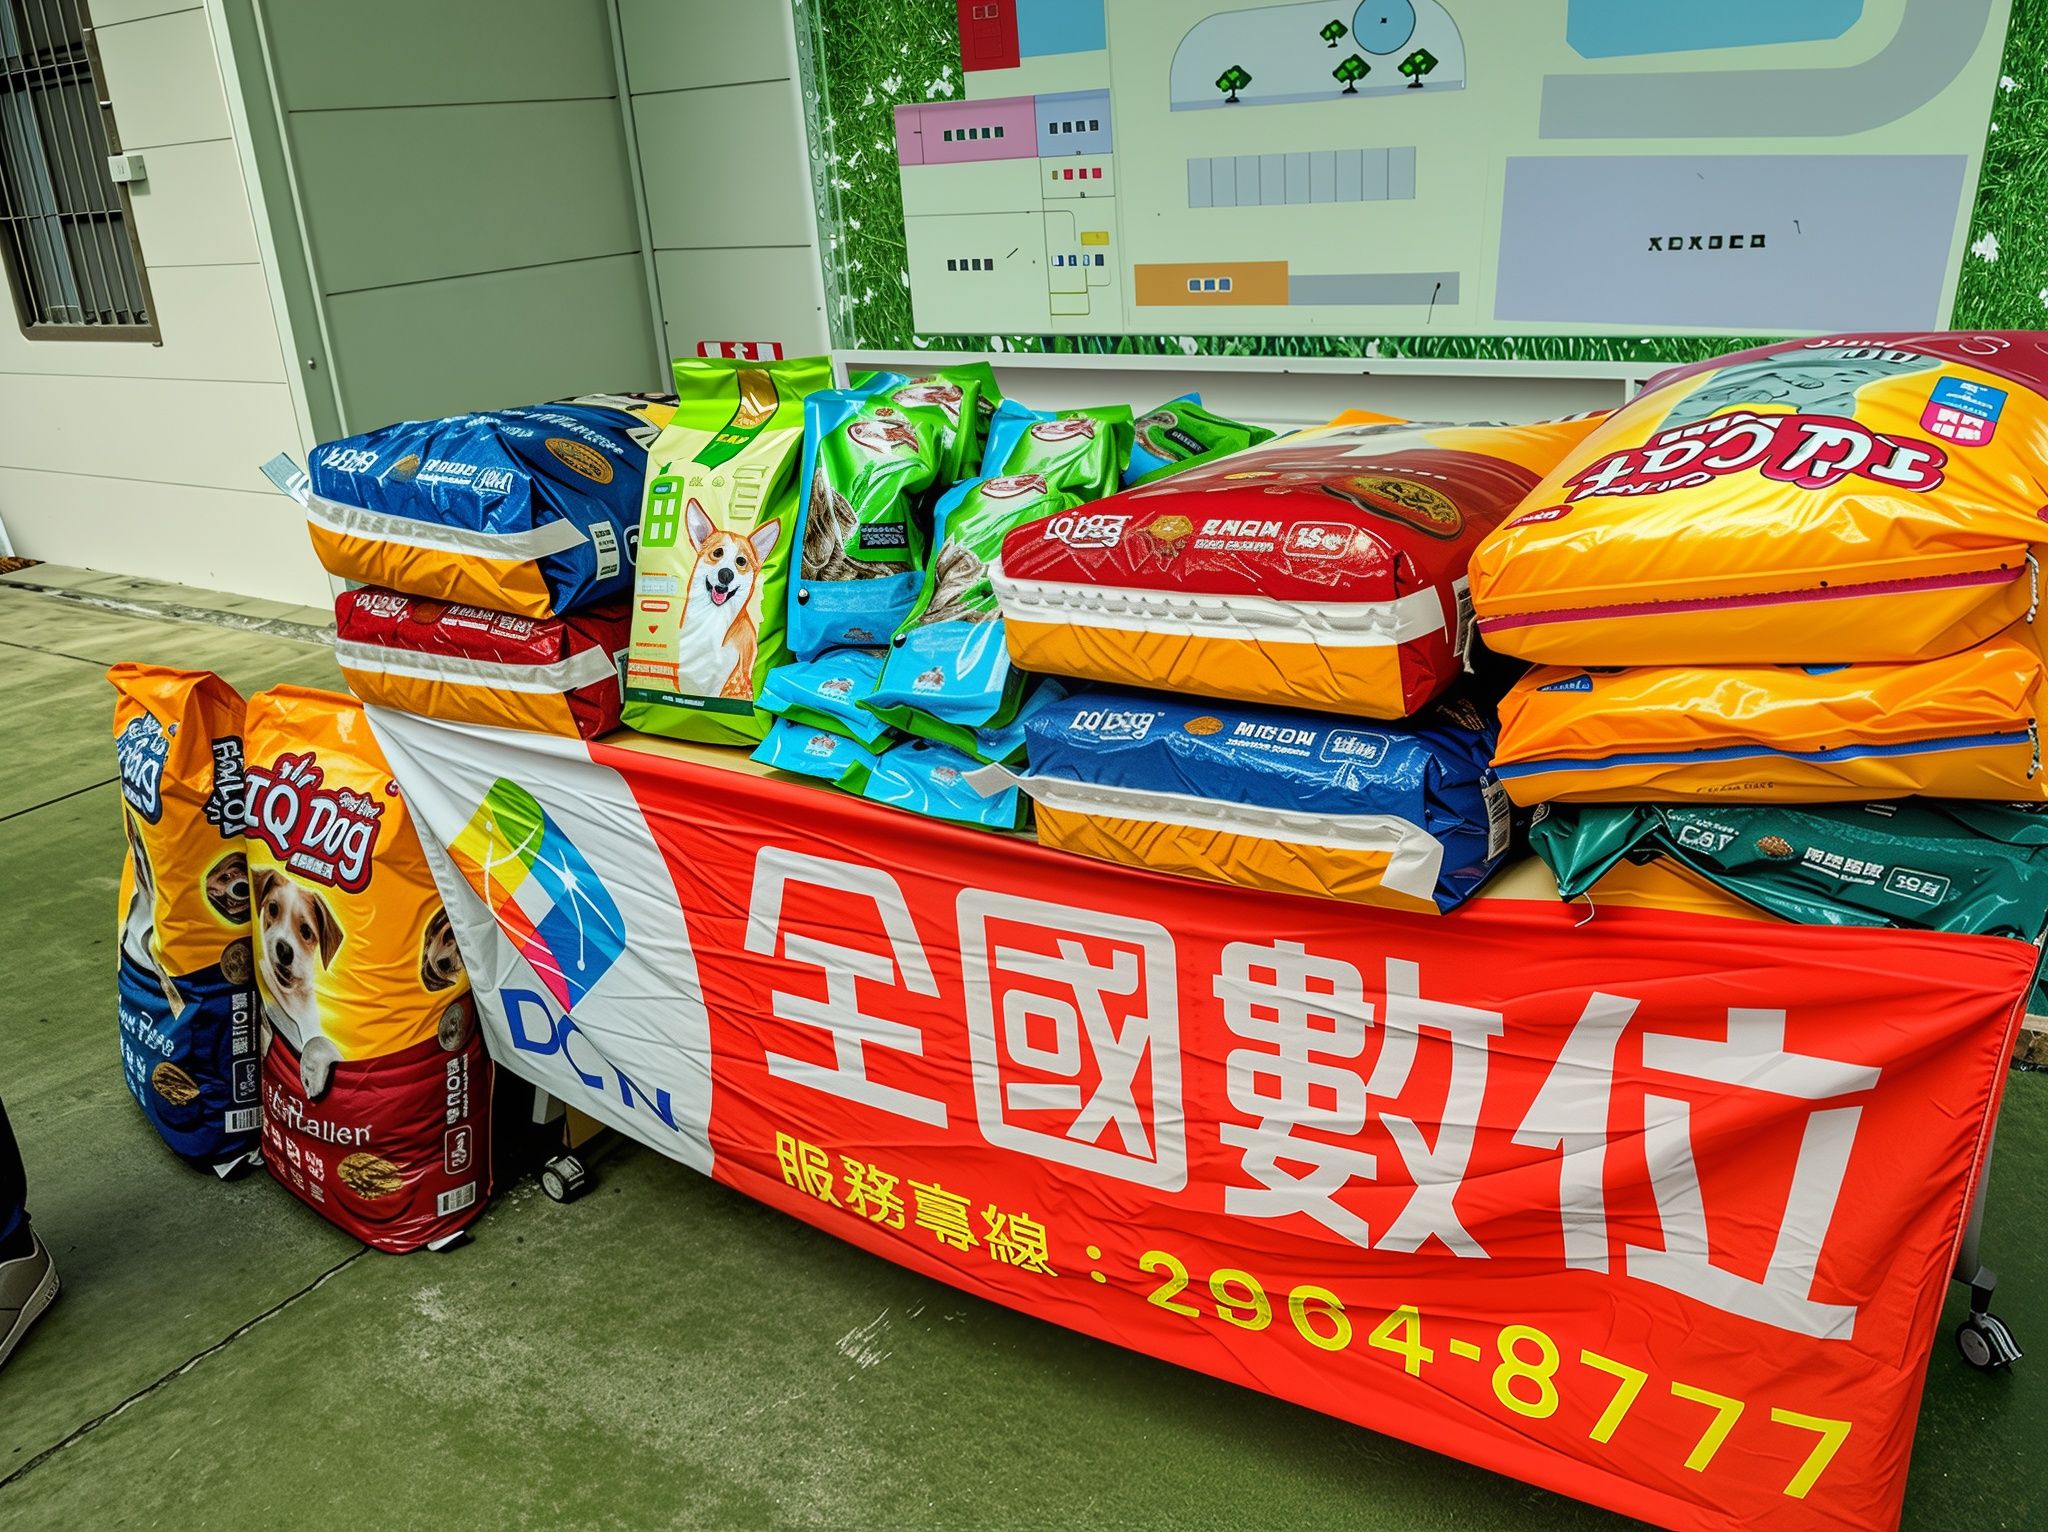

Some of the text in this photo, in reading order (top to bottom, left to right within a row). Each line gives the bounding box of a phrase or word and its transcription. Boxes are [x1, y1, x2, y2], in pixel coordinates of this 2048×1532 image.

[244, 774, 299, 851] IQ
[301, 796, 374, 881] Dog
[499, 988, 680, 1132] DCN
[744, 846, 1882, 1341] 全國數位
[1138, 1250, 1853, 1500] 2964-8777
